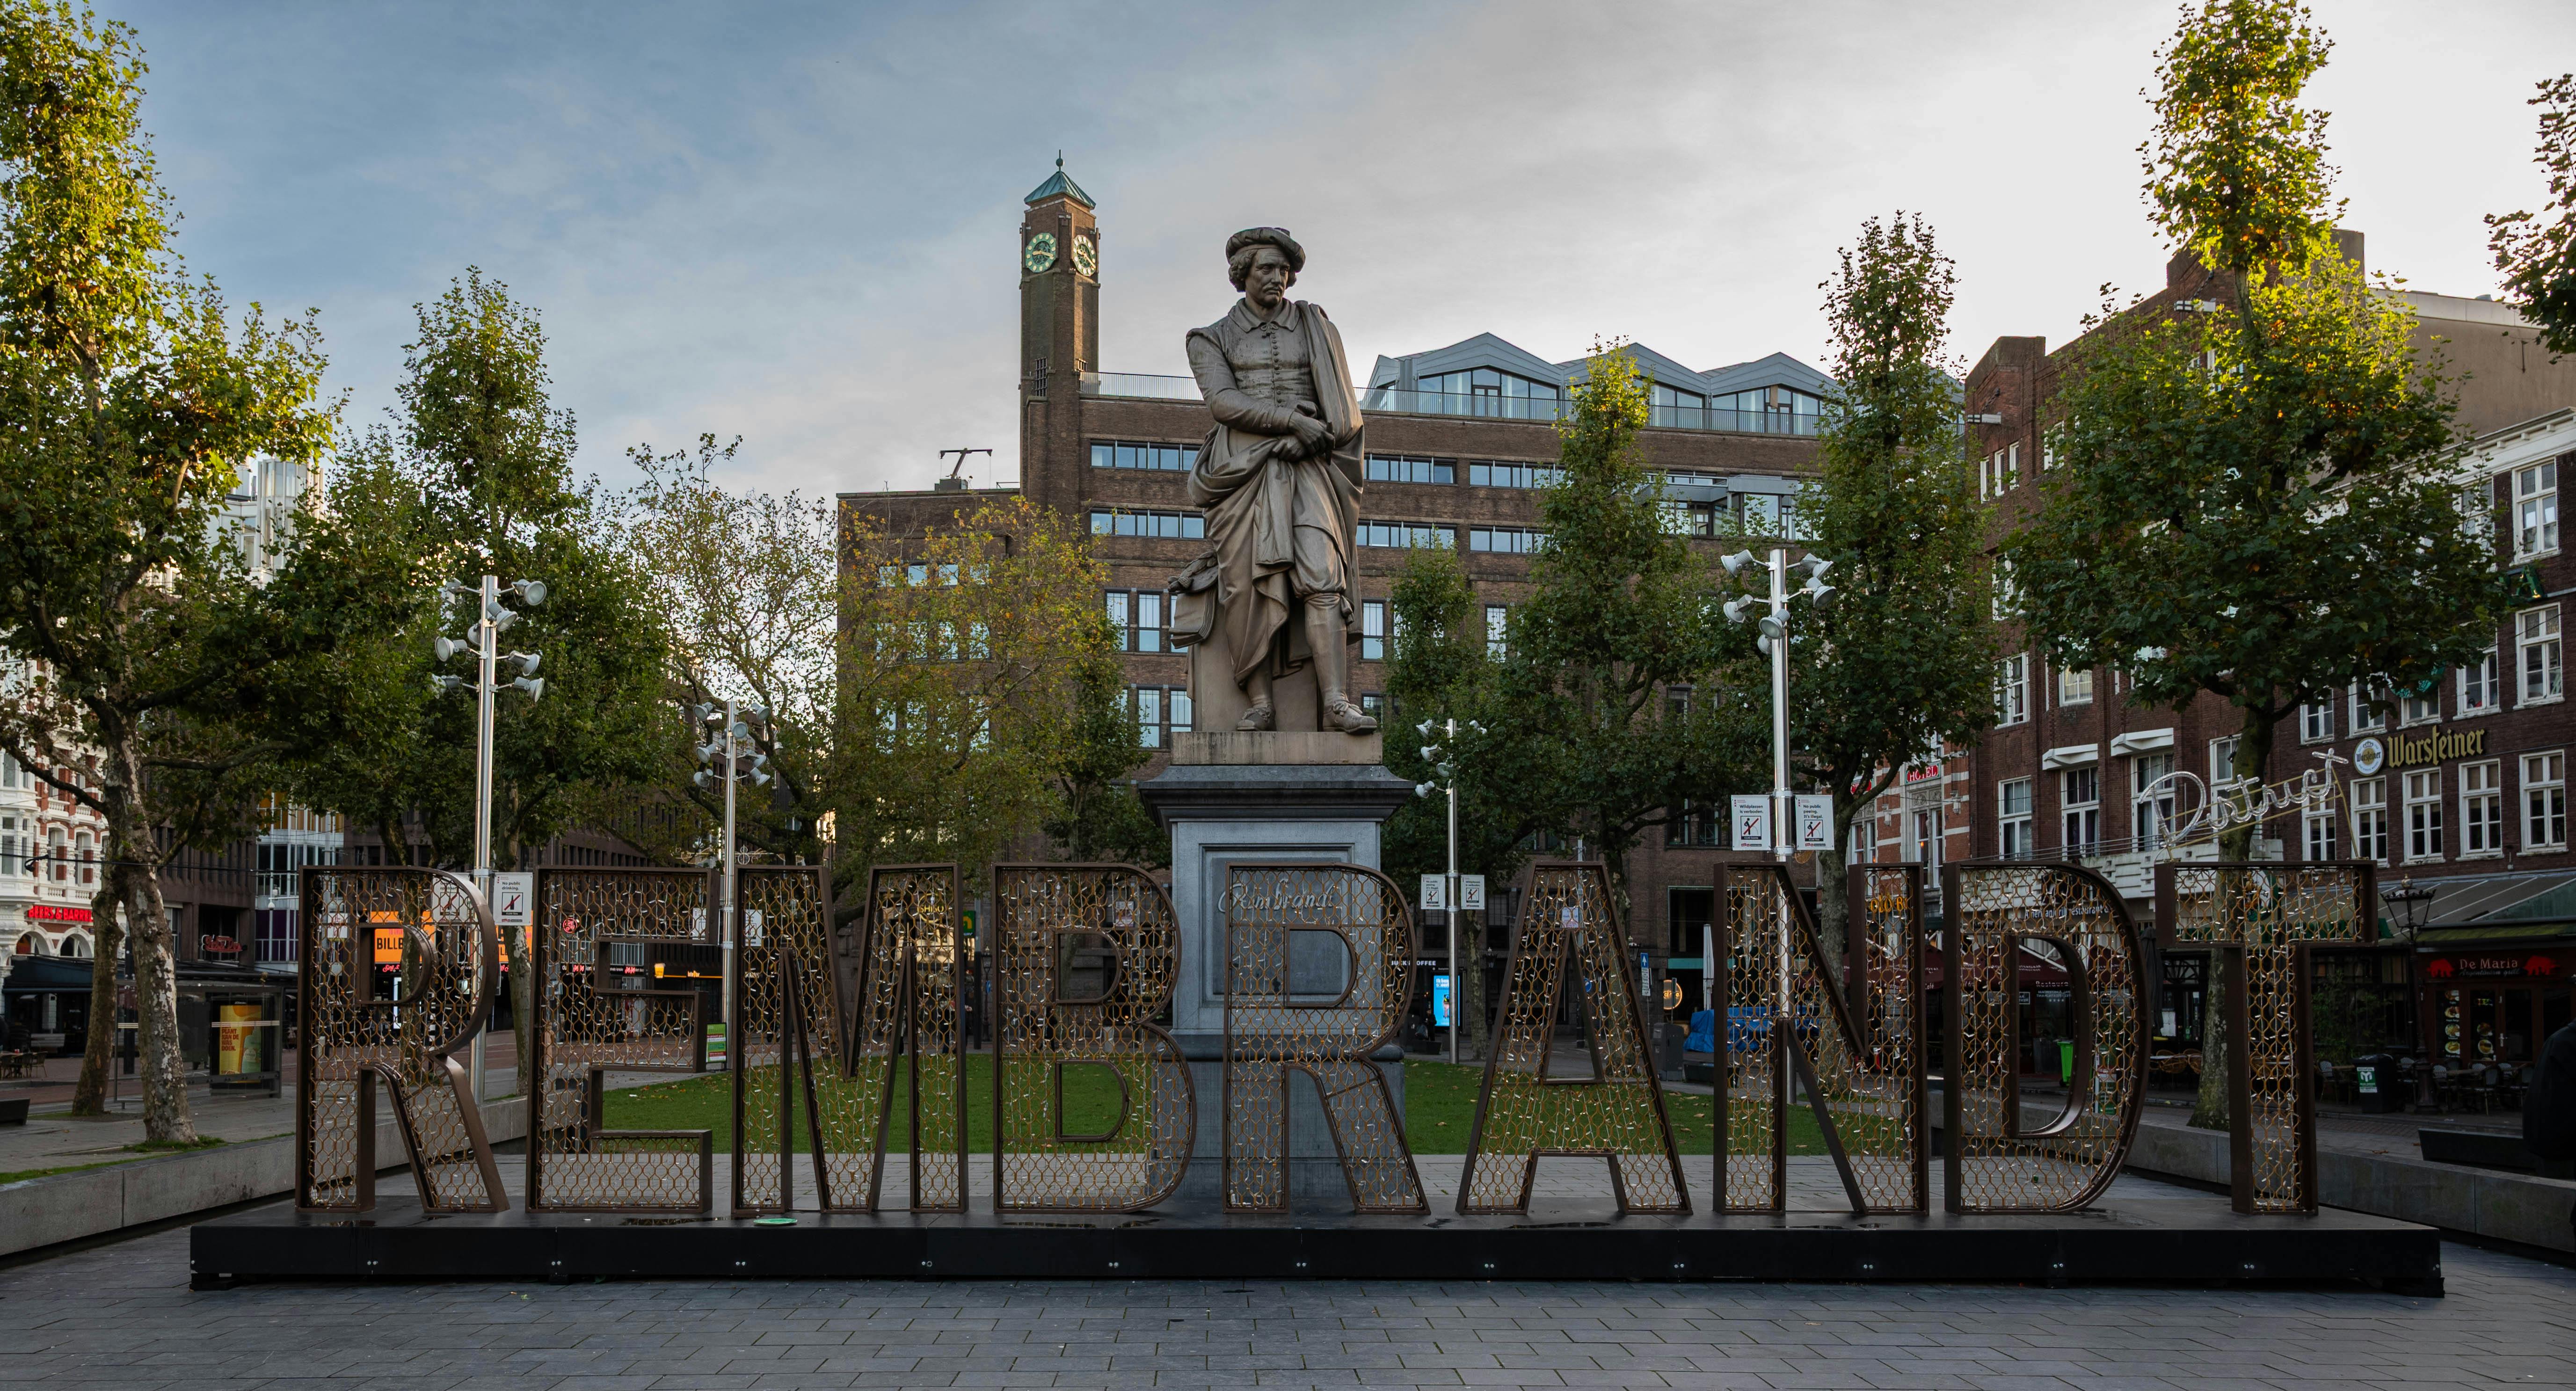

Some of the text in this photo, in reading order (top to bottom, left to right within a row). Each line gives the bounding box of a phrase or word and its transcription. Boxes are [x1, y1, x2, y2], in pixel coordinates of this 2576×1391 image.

[2387, 724, 2485, 768] Warsteiner
[2356, 751, 2381, 762] Warsteiner
[28, 905, 94, 923] BEERS & BARREL
[377, 938, 403, 949] BILLB
[2460, 958, 2518, 969] De Maria
[297, 860, 2377, 1217] REMBRANDT
